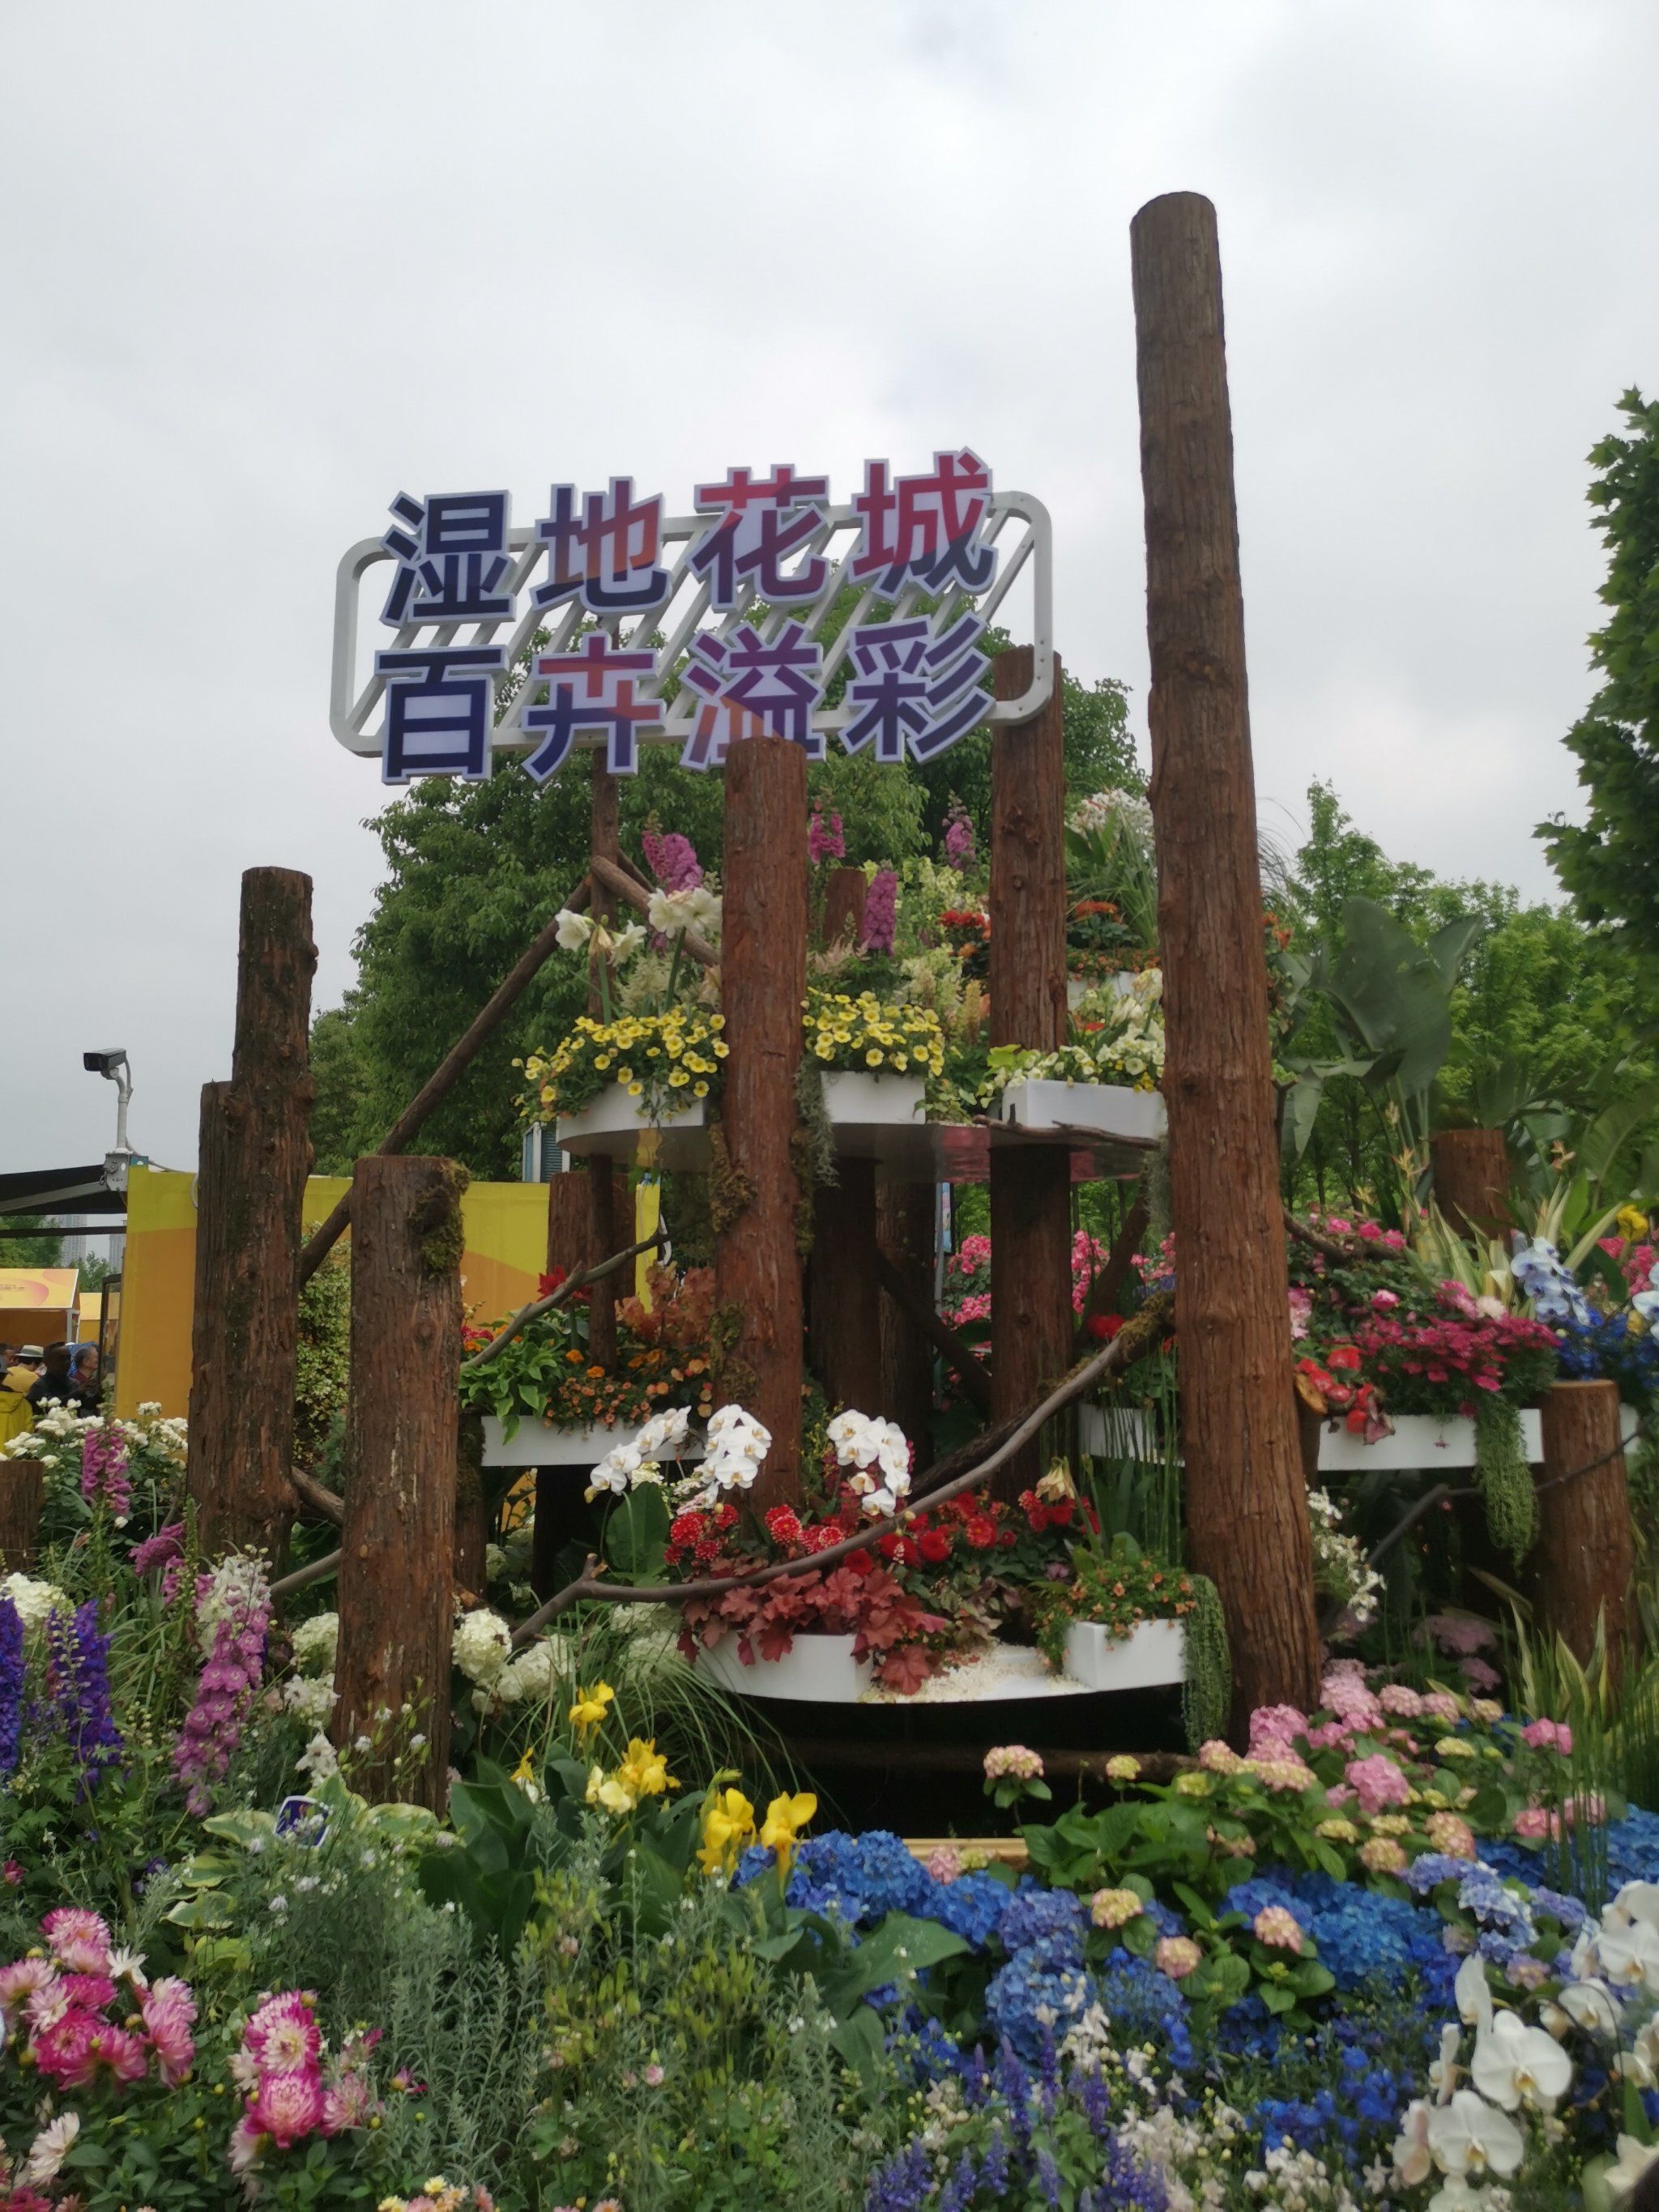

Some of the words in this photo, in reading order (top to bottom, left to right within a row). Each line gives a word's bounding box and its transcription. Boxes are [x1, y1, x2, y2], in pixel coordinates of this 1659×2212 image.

[384, 451, 992, 623] 湿地花城
[377, 618, 989, 780] 百卉溢彩
